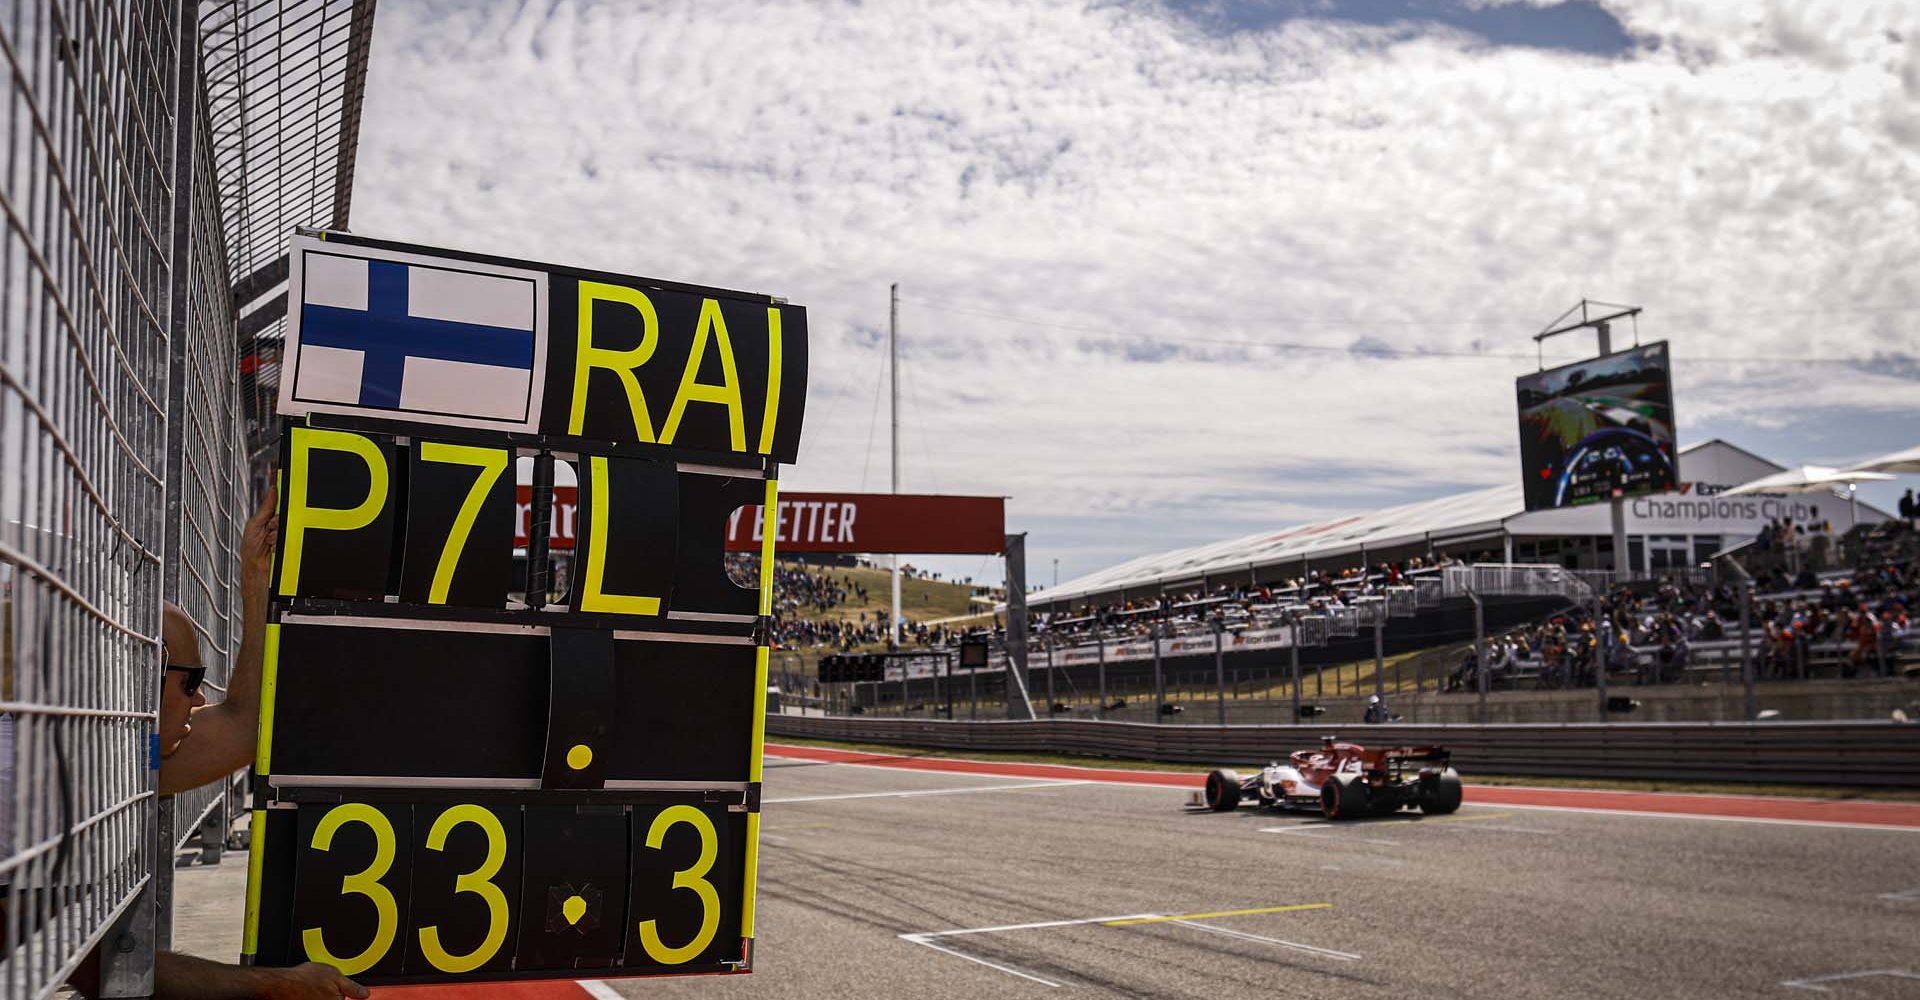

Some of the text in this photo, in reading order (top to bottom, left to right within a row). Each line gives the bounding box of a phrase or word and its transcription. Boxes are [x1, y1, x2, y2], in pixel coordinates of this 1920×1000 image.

[568, 279, 783, 455] RAI
[752, 501, 857, 543] BETTER
[1632, 498, 1808, 521] Champions Club
